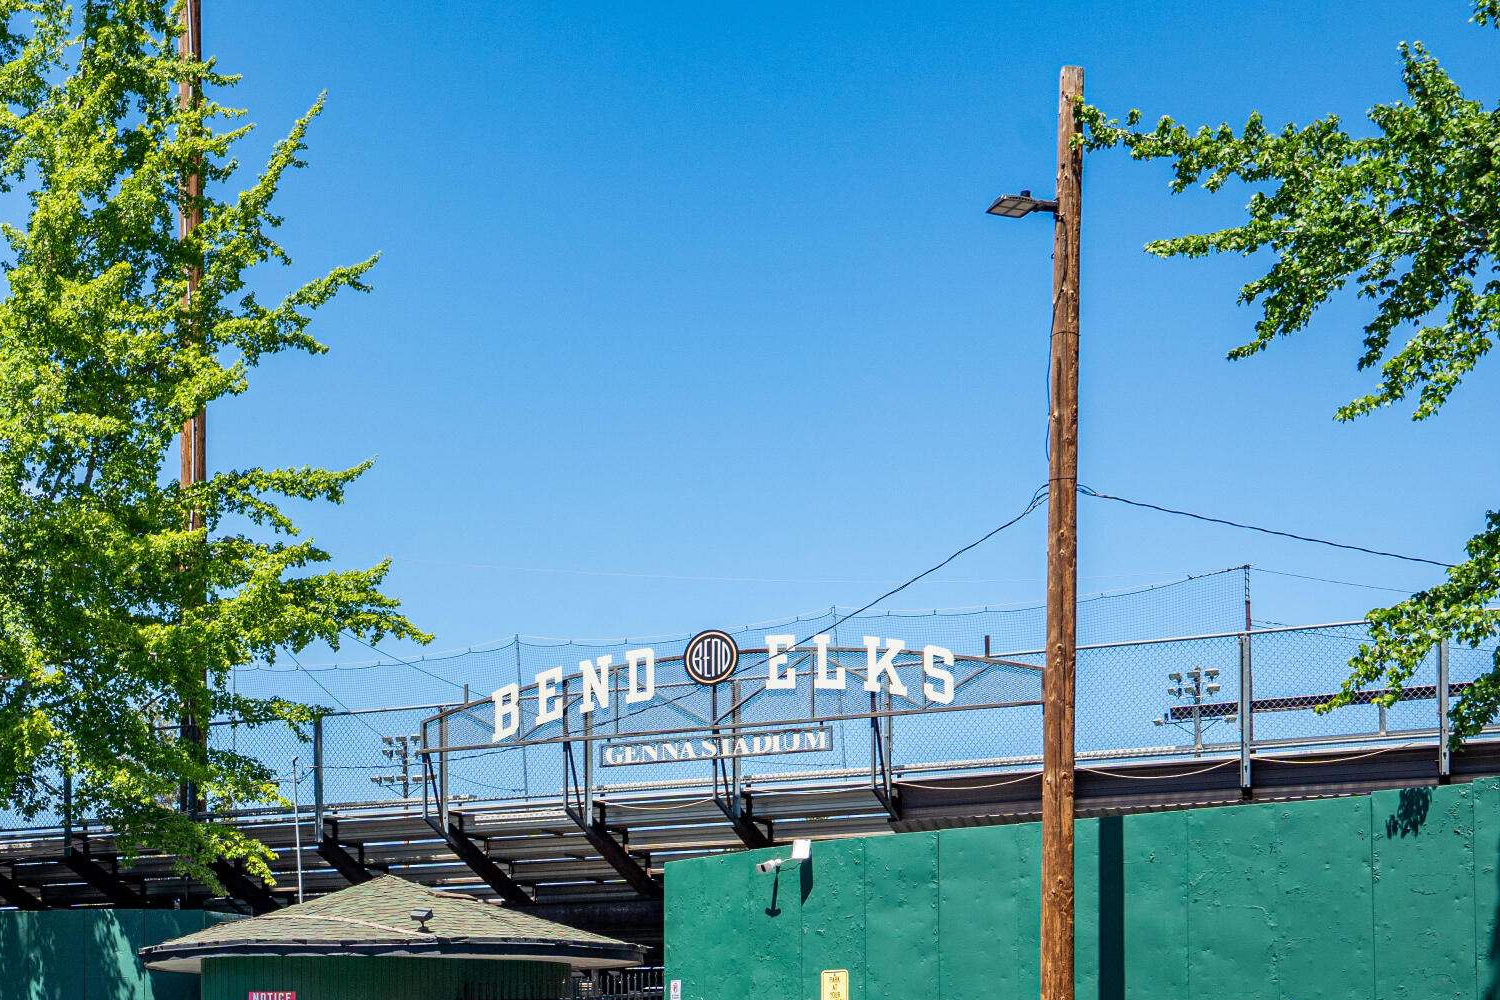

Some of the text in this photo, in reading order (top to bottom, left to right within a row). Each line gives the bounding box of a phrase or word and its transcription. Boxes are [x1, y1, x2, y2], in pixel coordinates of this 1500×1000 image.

[692, 638, 730, 677] BEND
[491, 634, 955, 743] BEND ELKS
[606, 731, 826, 765] GENNA STADIUM
